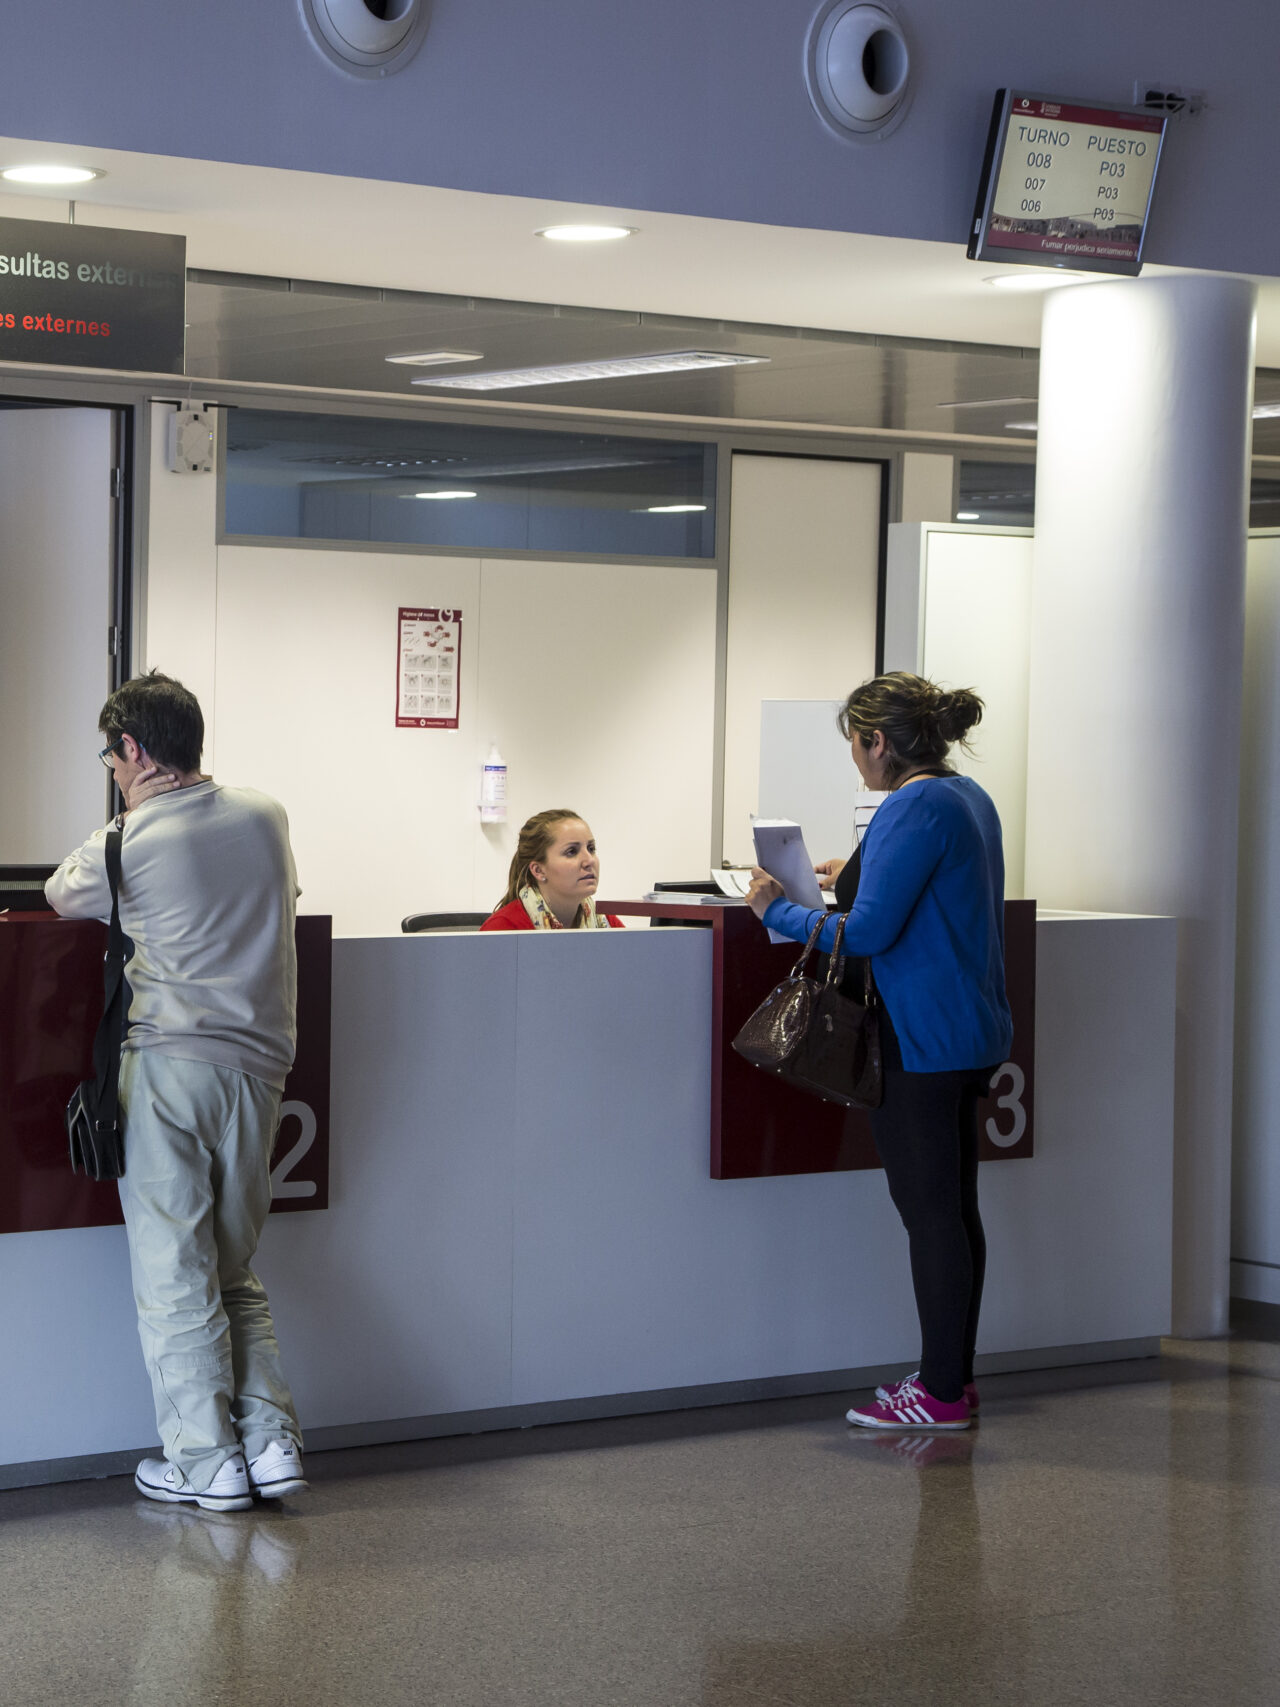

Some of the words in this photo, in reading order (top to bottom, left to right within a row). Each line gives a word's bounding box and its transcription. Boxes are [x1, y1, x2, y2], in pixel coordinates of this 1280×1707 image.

[1019, 126, 1070, 147] TURNO
[1087, 136, 1147, 157] PUESTO
[1027, 152, 1052, 169] 008
[1099, 161, 1126, 178] P03
[1025, 178, 1046, 191] 007
[1097, 186, 1119, 200] P03
[1021, 199, 1041, 212] 006
[1093, 207, 1114, 221] P03
[1041, 239, 1064, 249] Fumar
[77, 261, 177, 288] exter
[22, 314, 111, 337] externes
[985, 1062, 1026, 1148] 3
[270, 1100, 317, 1199] 2
